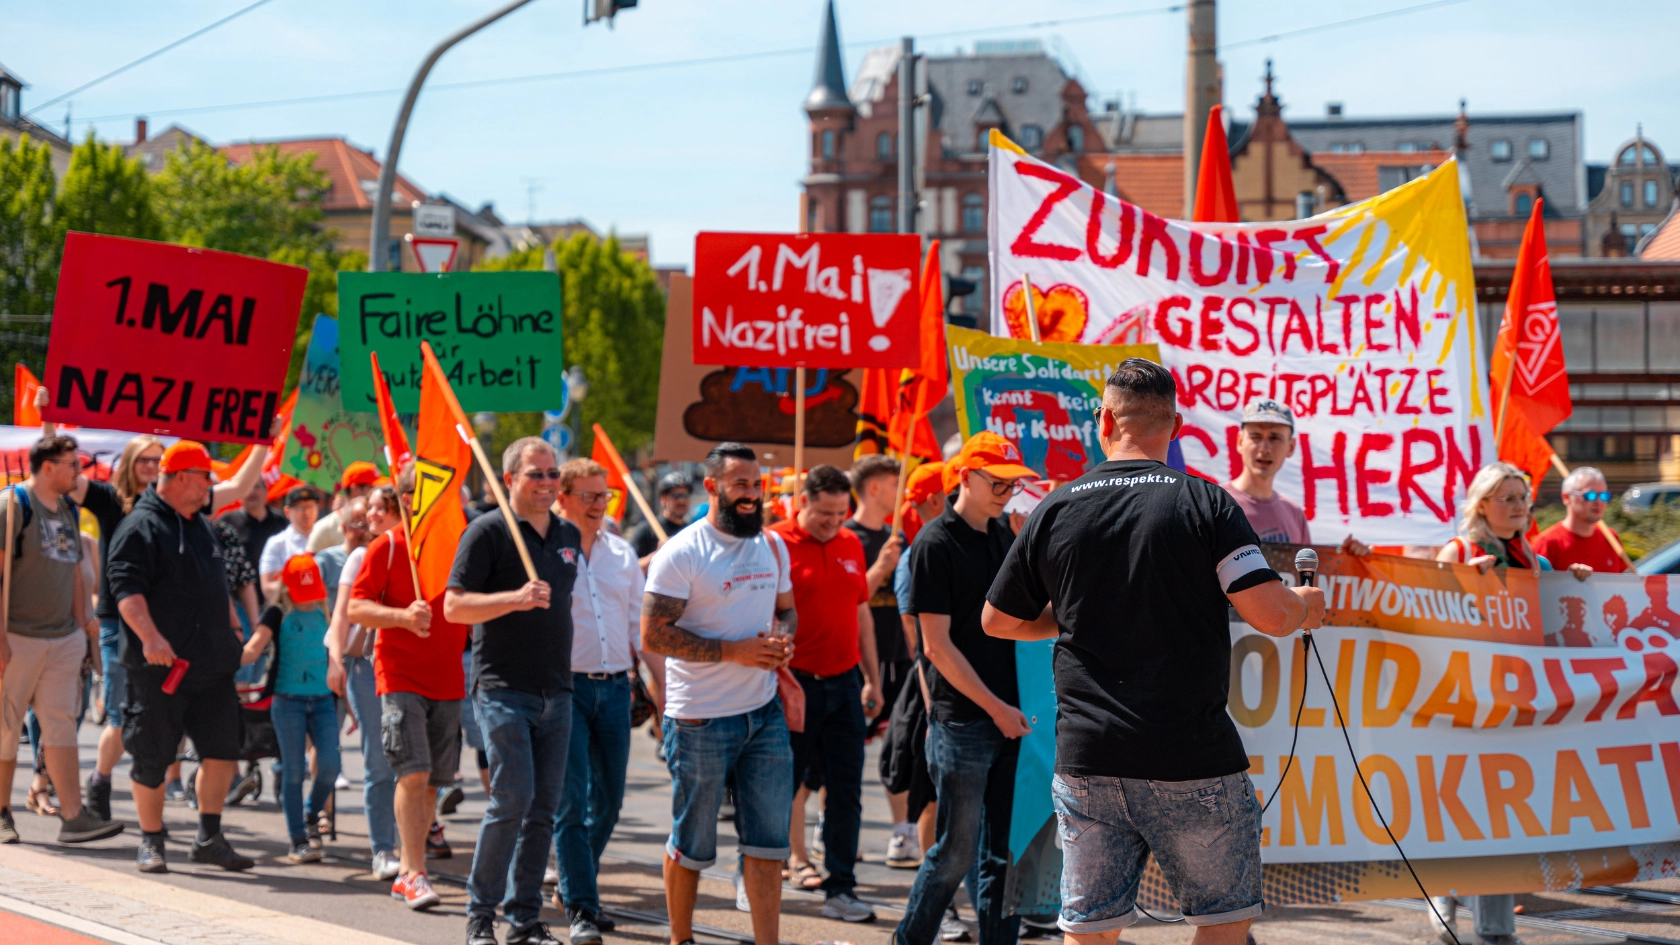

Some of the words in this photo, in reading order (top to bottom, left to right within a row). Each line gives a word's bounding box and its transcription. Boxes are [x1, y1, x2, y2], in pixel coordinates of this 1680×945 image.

[1010, 160, 1340, 287] ZUKUNFT
[106, 275, 256, 346] 1.MAI
[360, 292, 447, 346] Faire
[455, 291, 553, 338] Löhne
[306, 363, 340, 397] VER
[446, 355, 541, 389] Arbeit
[954, 344, 1017, 371] Unsere
[1022, 353, 1119, 380] Solidarit
[56, 365, 194, 422] NAZI
[202, 387, 278, 440] FREI
[1058, 391, 1102, 411] kein
[1071, 473, 1177, 493] www.respekt.tv
[1485, 590, 1532, 631] FÜR
[1228, 632, 1680, 729] OLIDARITÄ
